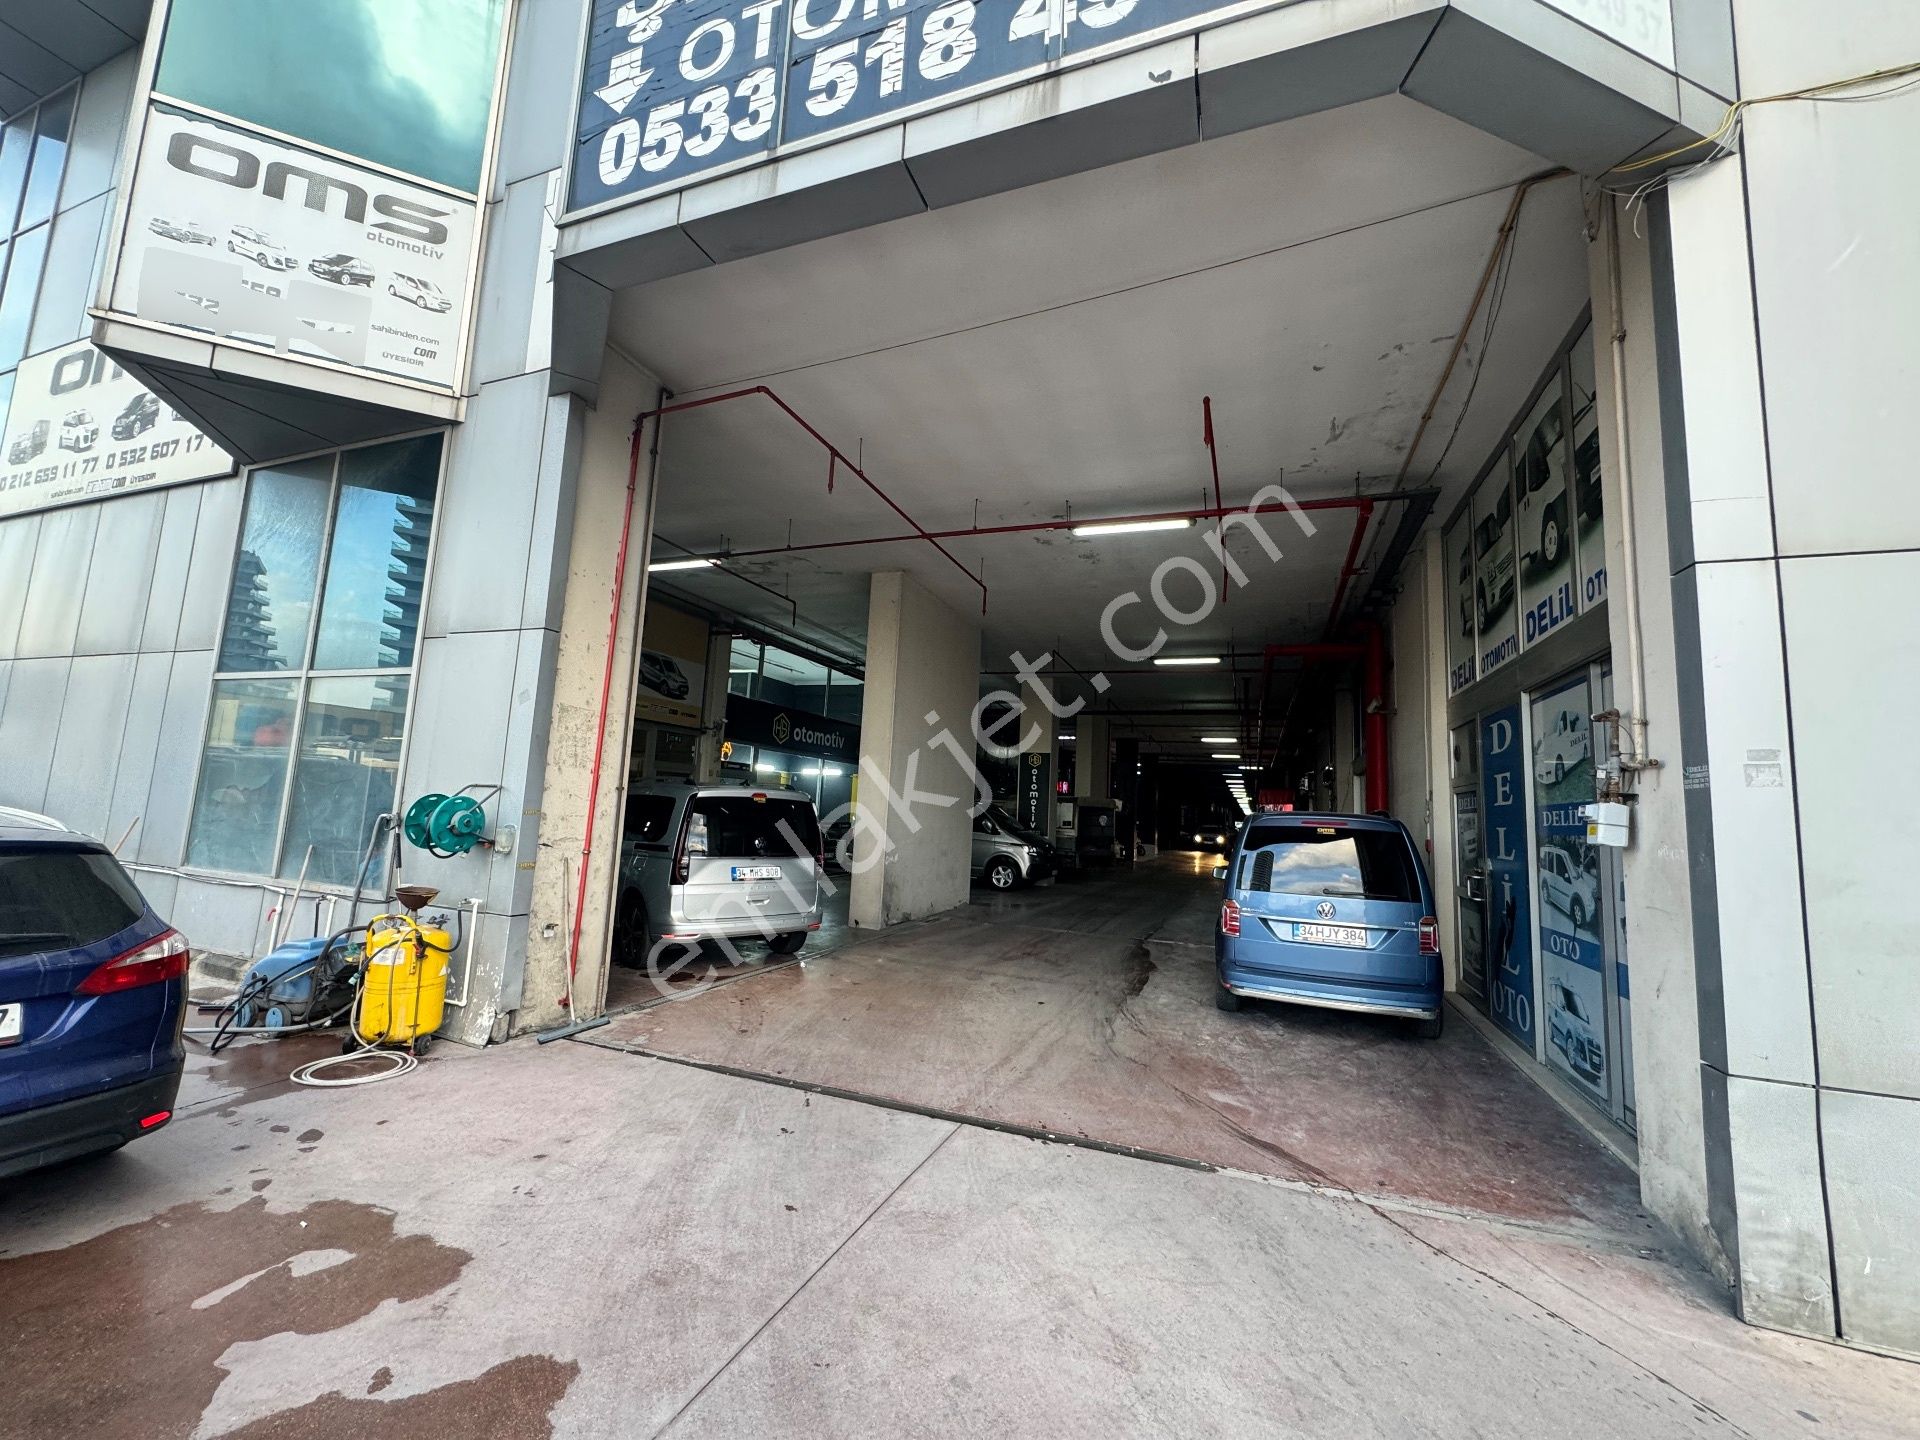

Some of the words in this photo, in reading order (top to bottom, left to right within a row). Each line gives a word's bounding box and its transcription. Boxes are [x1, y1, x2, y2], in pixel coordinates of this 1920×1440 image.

[598, 67, 777, 186] 0533
[805, 0, 978, 117] 518
[366, 231, 444, 260] otomotiv
[371, 324, 440, 346] sahibinden.com
[9, 470, 33, 489] 212
[34, 464, 59, 484] 659
[62, 460, 77, 479] 11
[82, 455, 100, 475] 77
[105, 453, 116, 470] 0
[118, 446, 148, 468] 532
[150, 438, 180, 460] 607
[186, 433, 206, 454] 17
[1525, 581, 1573, 645] DELİL
[793, 726, 845, 749] otomotiv
[1569, 733, 1588, 747] DELİL
[1029, 768, 1039, 829] otomotiv
[1489, 719, 1520, 976] DELİL
[1300, 925, 1313, 937] 34
[1315, 926, 1340, 939] HJY
[1343, 929, 1364, 942] 384
[1551, 934, 1580, 961] OTO
[1492, 979, 1531, 1033] OTO
